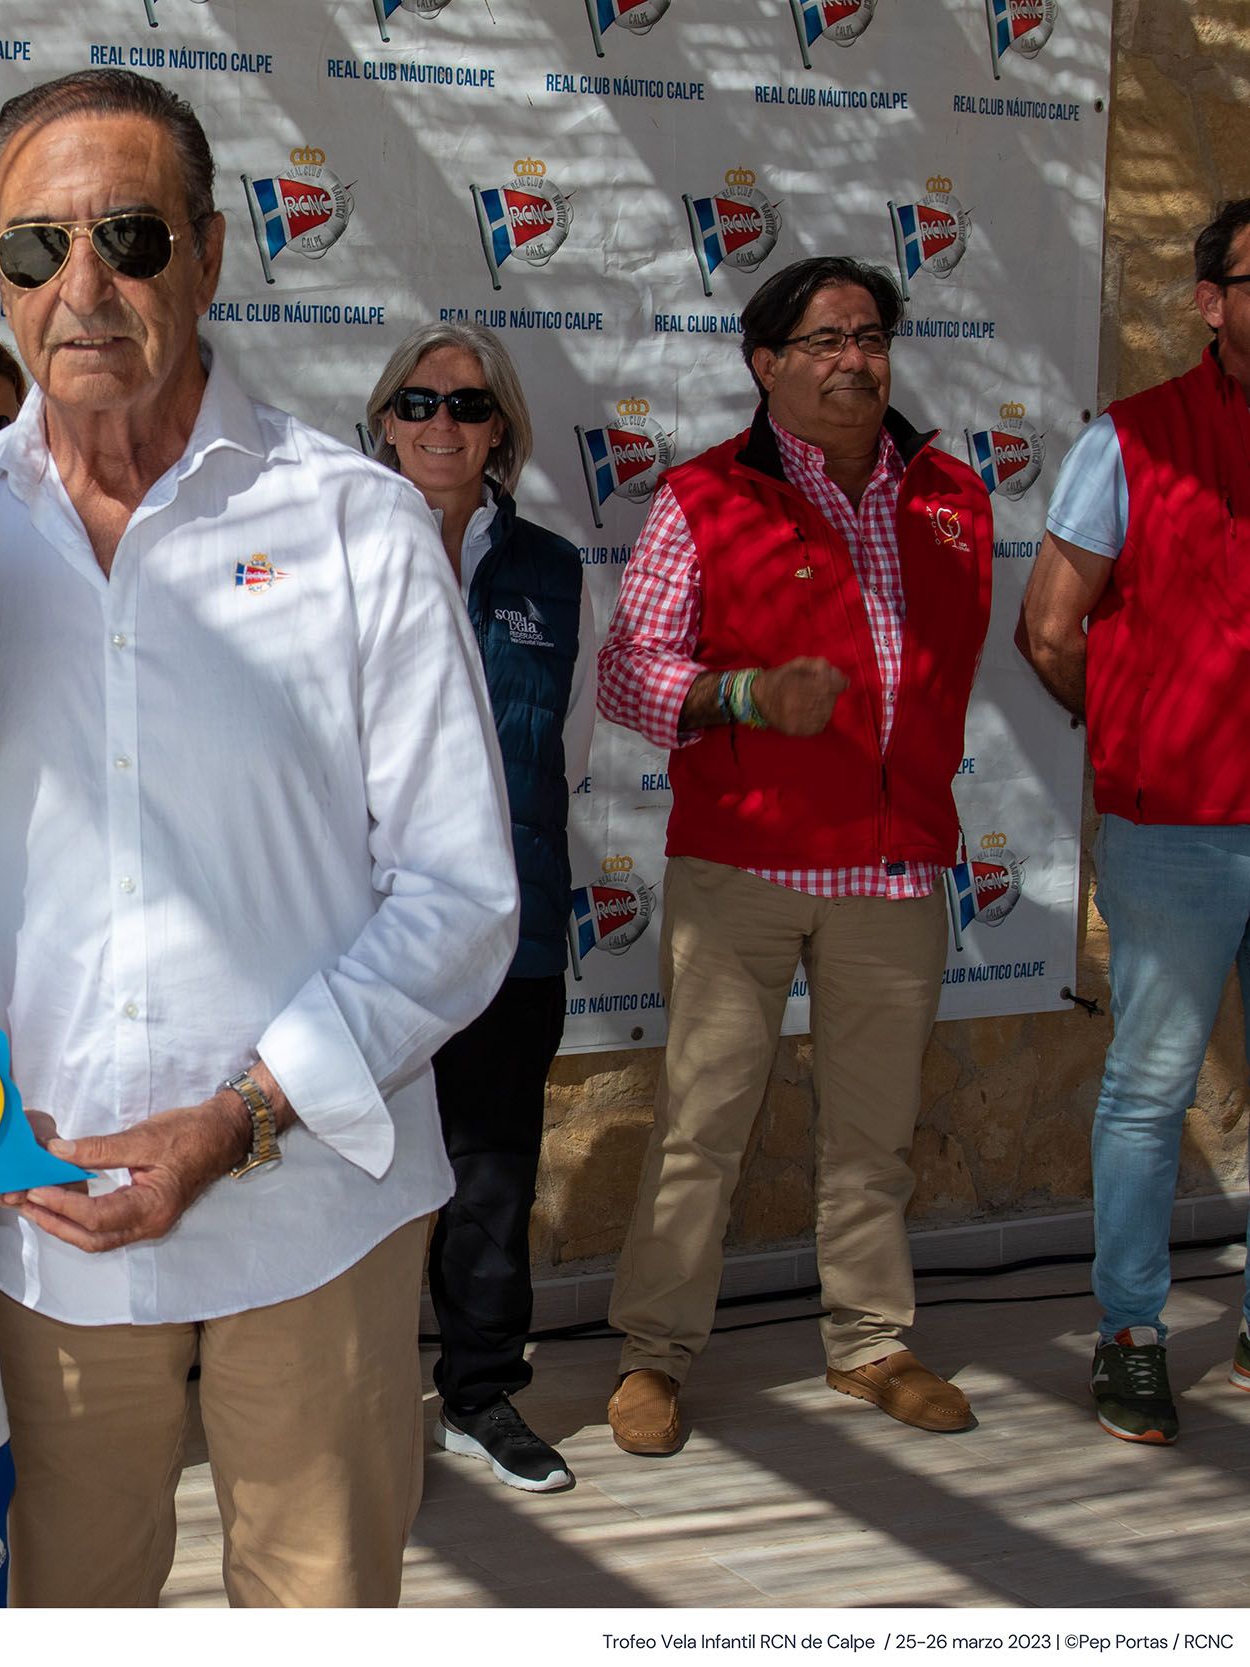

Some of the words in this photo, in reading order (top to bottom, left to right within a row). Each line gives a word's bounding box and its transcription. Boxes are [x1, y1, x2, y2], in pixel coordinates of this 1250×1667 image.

[91, 45, 126, 65] REAL
[130, 47, 165, 67] CLUB
[169, 46, 227, 71] NÁUTICO
[231, 53, 273, 73] CALPE
[327, 59, 360, 79] REAL
[364, 61, 397, 81] CLUB
[400, 61, 452, 85] NÁUTICO
[456, 68, 495, 87] CALPE
[546, 74, 576, 92] REAL
[580, 76, 610, 94] CLUB
[613, 75, 663, 98] NÁUTICO
[667, 81, 704, 100] CALPE
[755, 86, 785, 104] REAL
[788, 87, 815, 106] CLUB
[819, 87, 867, 108] NÁUTICO
[871, 92, 908, 109] CALPE
[954, 95, 976, 113] REAL
[979, 97, 1004, 116] CLUB
[1006, 97, 1046, 119] NÁUTICO
[1049, 103, 1080, 121] CALPE
[284, 193, 331, 218] RCNC
[509, 203, 552, 227] RCNC
[720, 212, 761, 236] RCNC
[920, 219, 955, 242] RCNC
[301, 235, 324, 249] CALPE
[526, 243, 547, 256] CALPE
[209, 303, 242, 322] REAL
[247, 304, 280, 322] CLUB
[284, 301, 340, 324] NÁUTICO
[344, 306, 385, 325] CALPE
[475, 309, 506, 328] CLUB
[510, 307, 561, 329] NÁUTICO
[565, 311, 603, 330] CALPE
[655, 315, 684, 332] REAL
[688, 315, 717, 333] CLUB
[916, 317, 959, 338] NÁUTICO
[962, 321, 995, 339] CALPE
[613, 441, 654, 465] RCNC
[995, 443, 1028, 465] RCNC
[494, 609, 522, 621] som
[509, 616, 537, 633] vela
[642, 773, 670, 791] REAL
[975, 870, 1008, 894] RCNC
[596, 896, 635, 920] RCNC
[968, 963, 1010, 982] NÁUTICO
[1014, 961, 1045, 978] CALPE
[565, 998, 586, 1016] LUB
[589, 993, 638, 1013] NÁUTICO
[641, 991, 665, 1009] CAL
